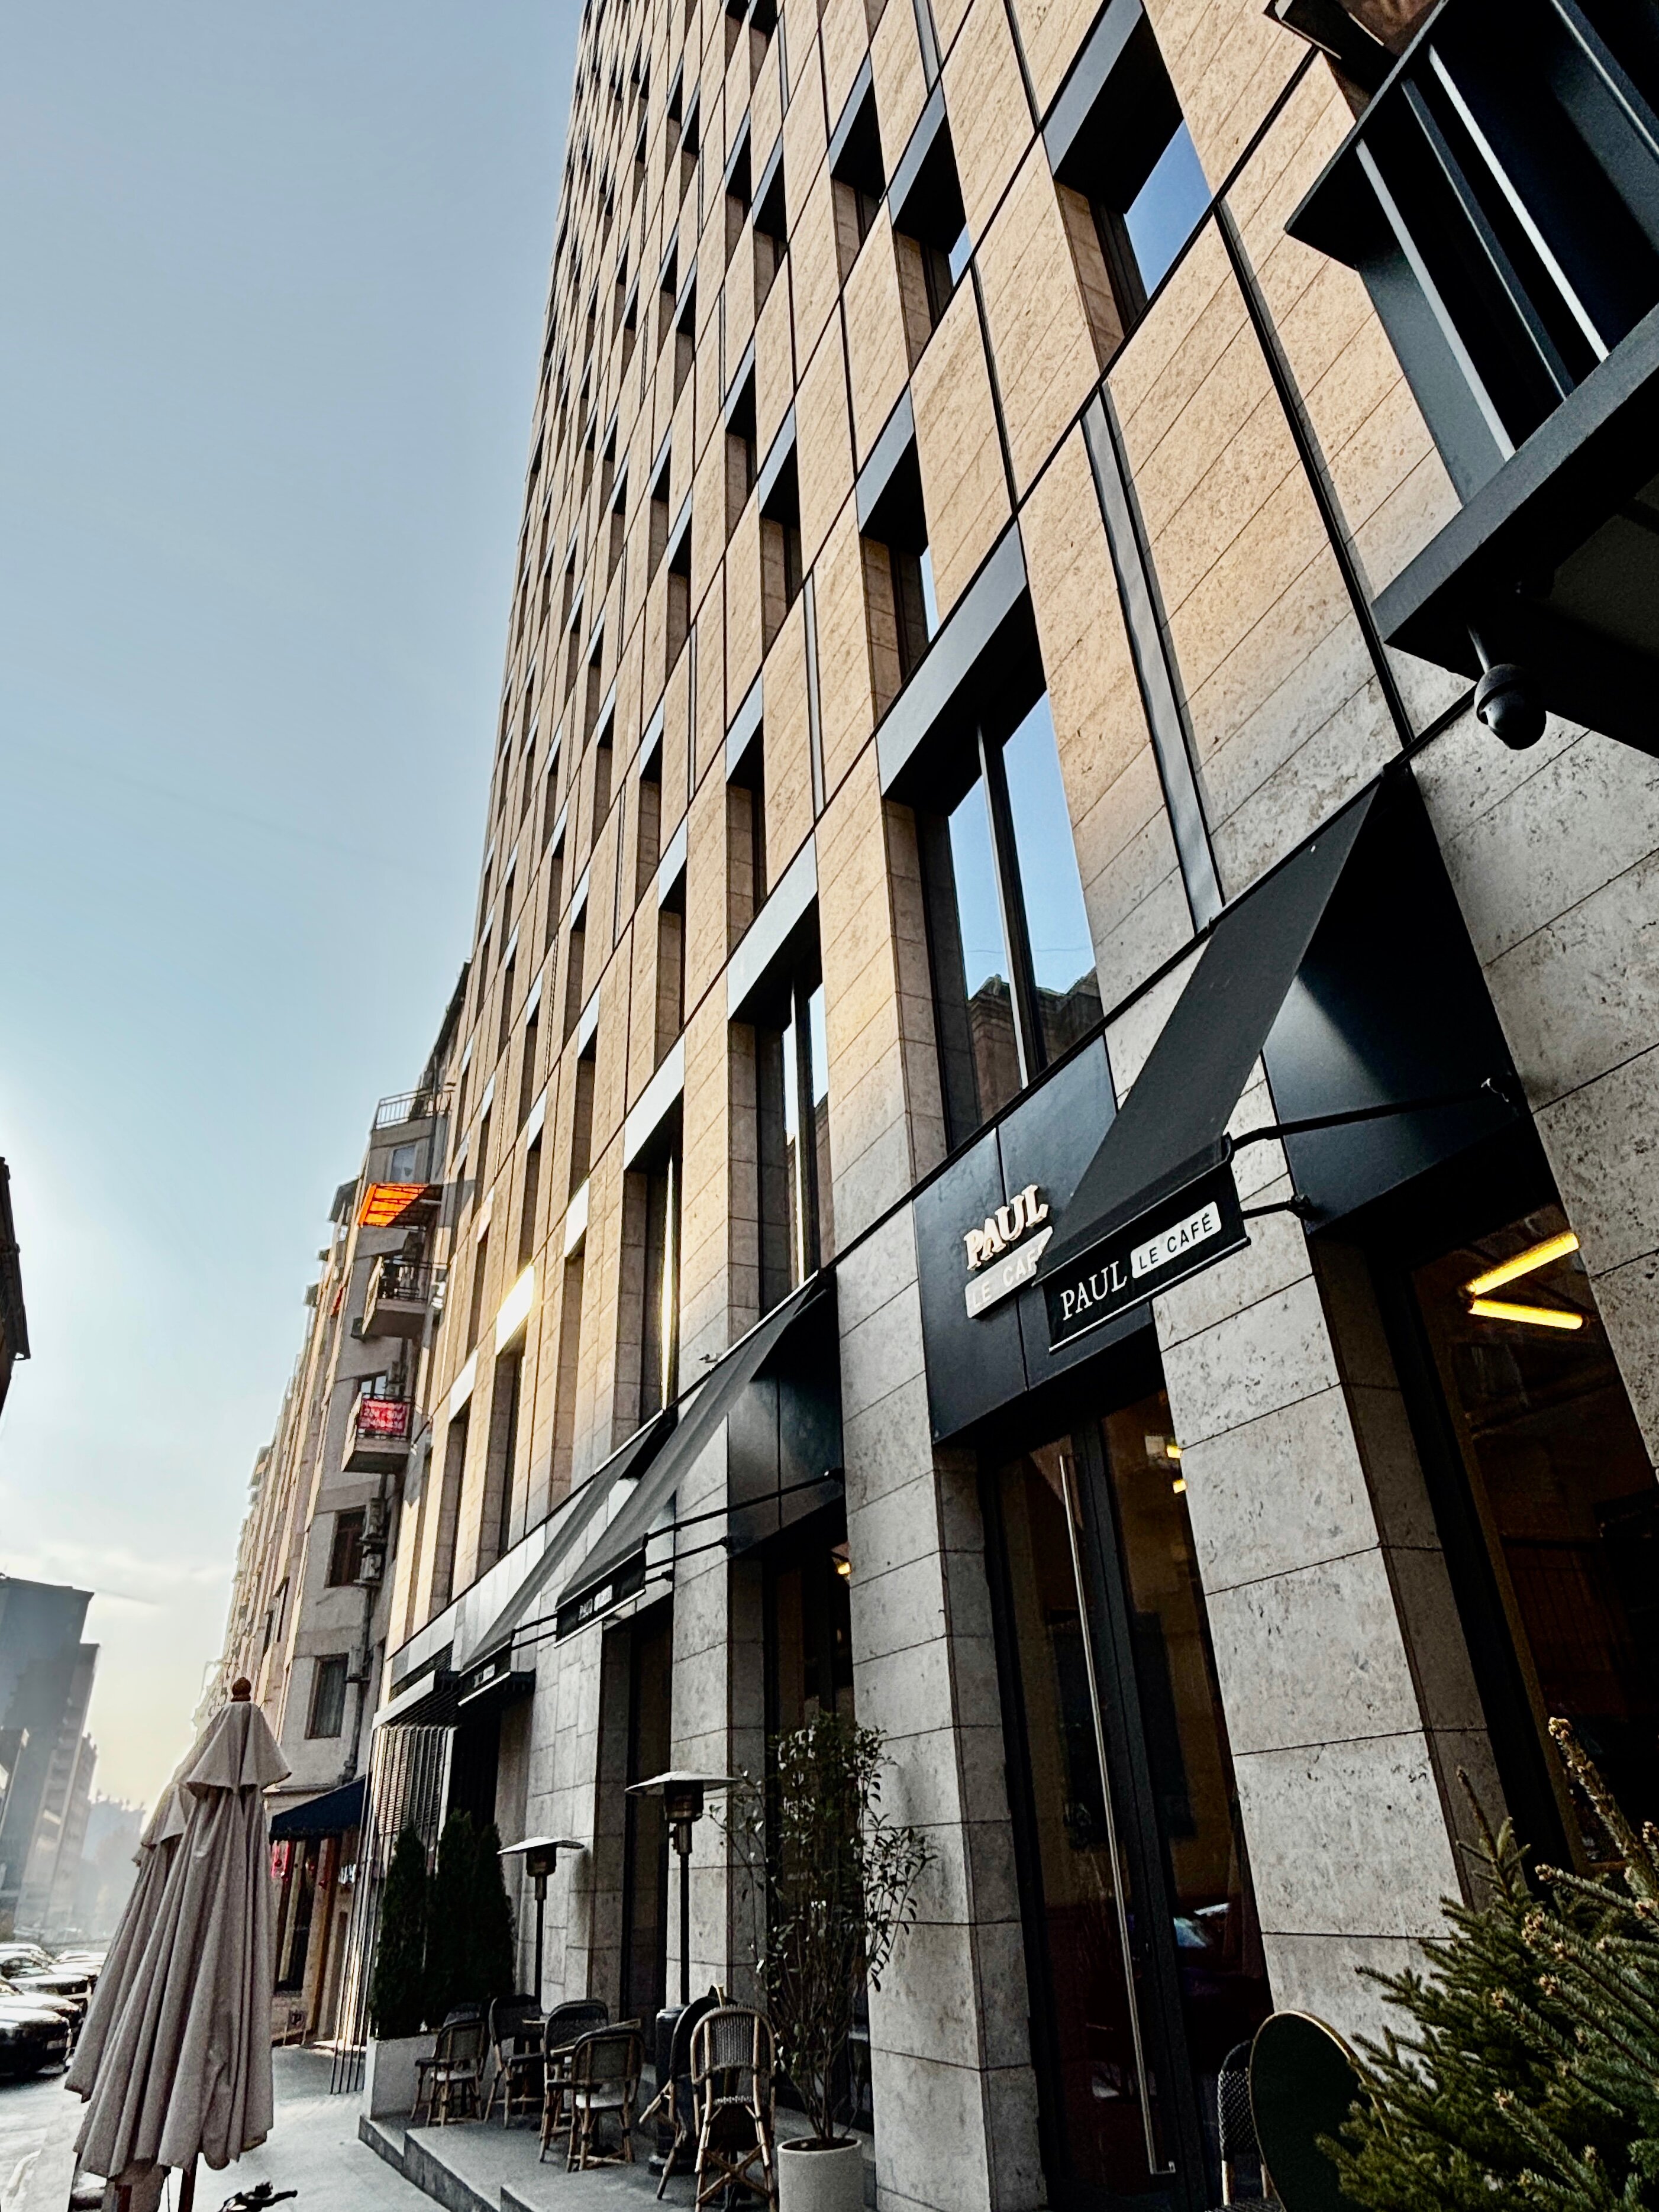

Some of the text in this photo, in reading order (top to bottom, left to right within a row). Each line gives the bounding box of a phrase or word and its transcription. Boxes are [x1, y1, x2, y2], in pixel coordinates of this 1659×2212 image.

[963, 1184, 1049, 1270] PAUL
[1060, 1213, 1213, 1320] PAUL LE CAFÉ
[971, 1280, 993, 1308] LE
